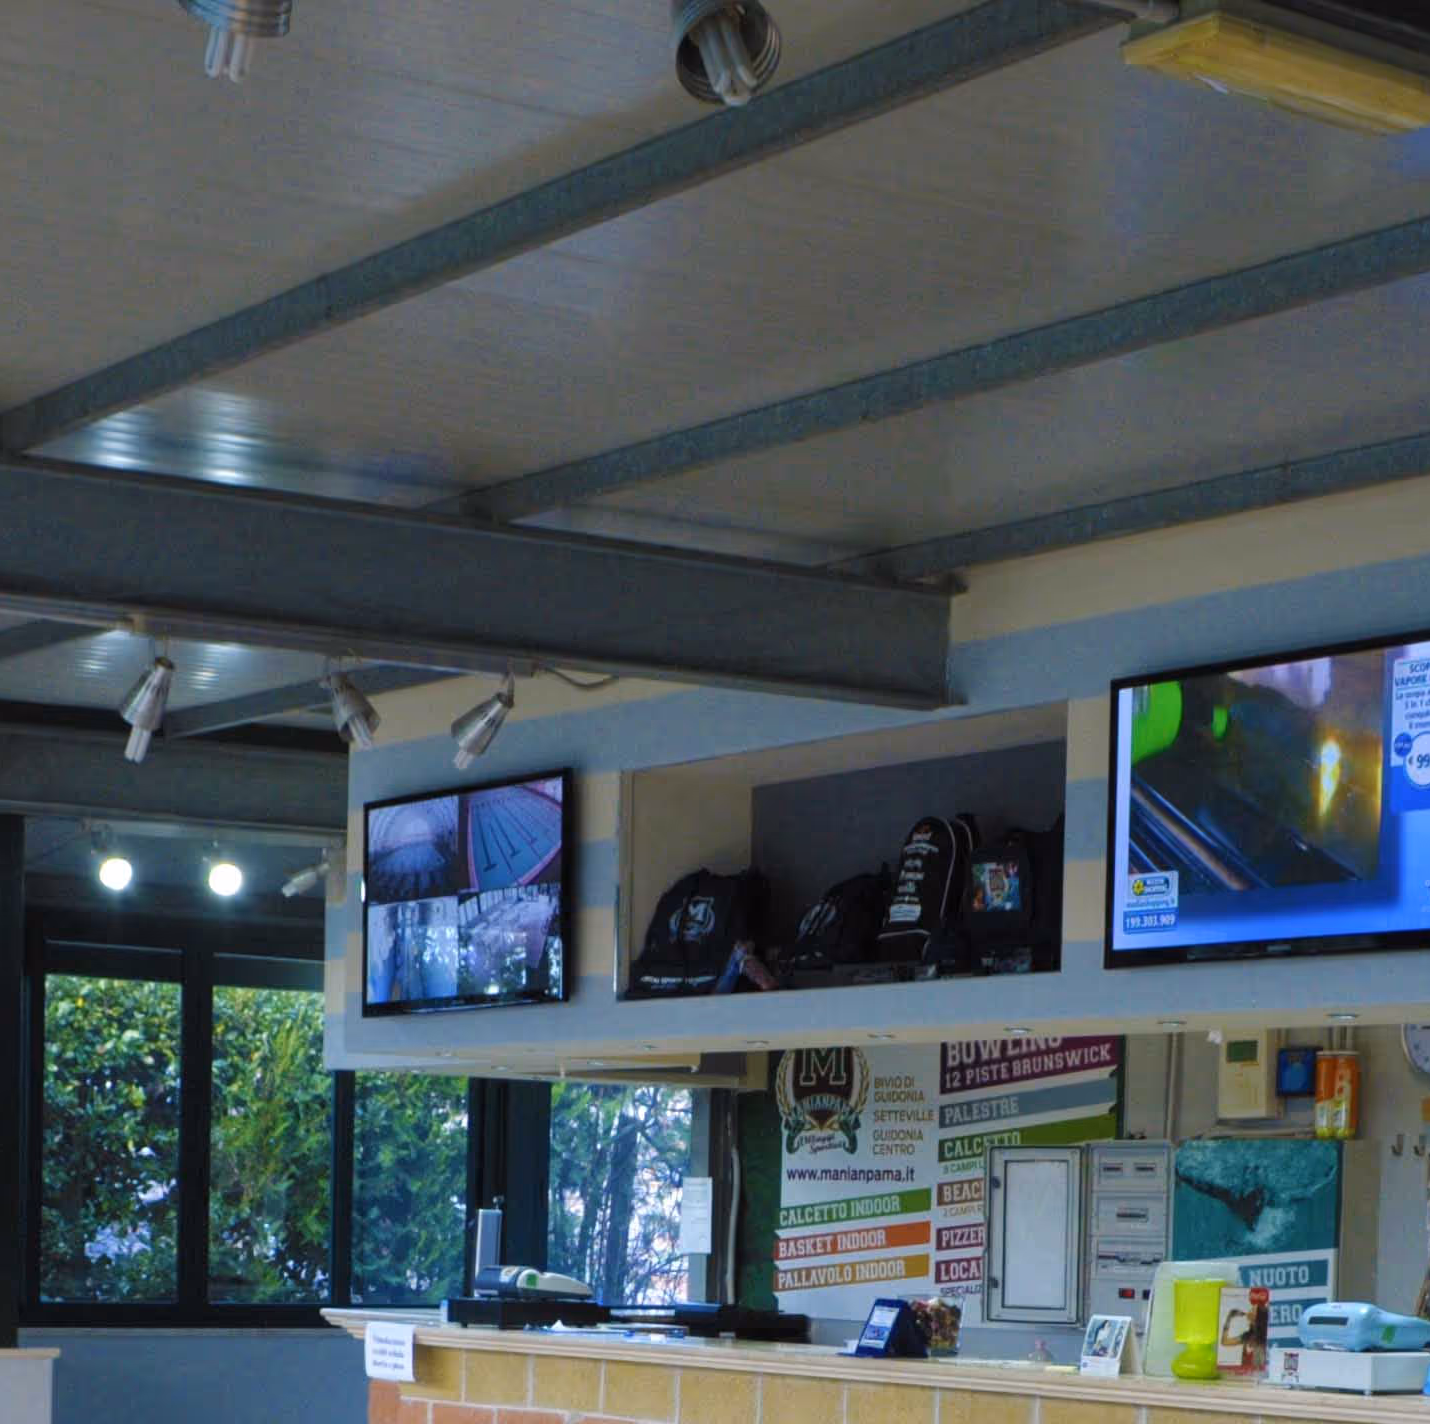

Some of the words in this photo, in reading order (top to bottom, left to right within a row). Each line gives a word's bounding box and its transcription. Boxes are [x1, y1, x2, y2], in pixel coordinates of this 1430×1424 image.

[946, 1071, 961, 1088] 12
[966, 1062, 1009, 1085] PISTE
[1012, 1043, 1112, 1077] BRUNSWICK
[874, 1090, 925, 1103] GUIDONIA
[874, 1109, 934, 1121] SETTEVILLE
[945, 1097, 1019, 1124] PALESTRE
[873, 1129, 924, 1142] GUIDONIA
[873, 1143, 916, 1156] CENTRO
[779, 1202, 848, 1226] CALCETTO
[851, 1195, 902, 1217] INDOOR
[779, 1235, 834, 1257] BASKET
[837, 1229, 887, 1250] INDOOR
[778, 1266, 852, 1289] PALLAVOLO
[856, 1259, 906, 1280] INDOOR
[1249, 1265, 1309, 1287] NUOTO
